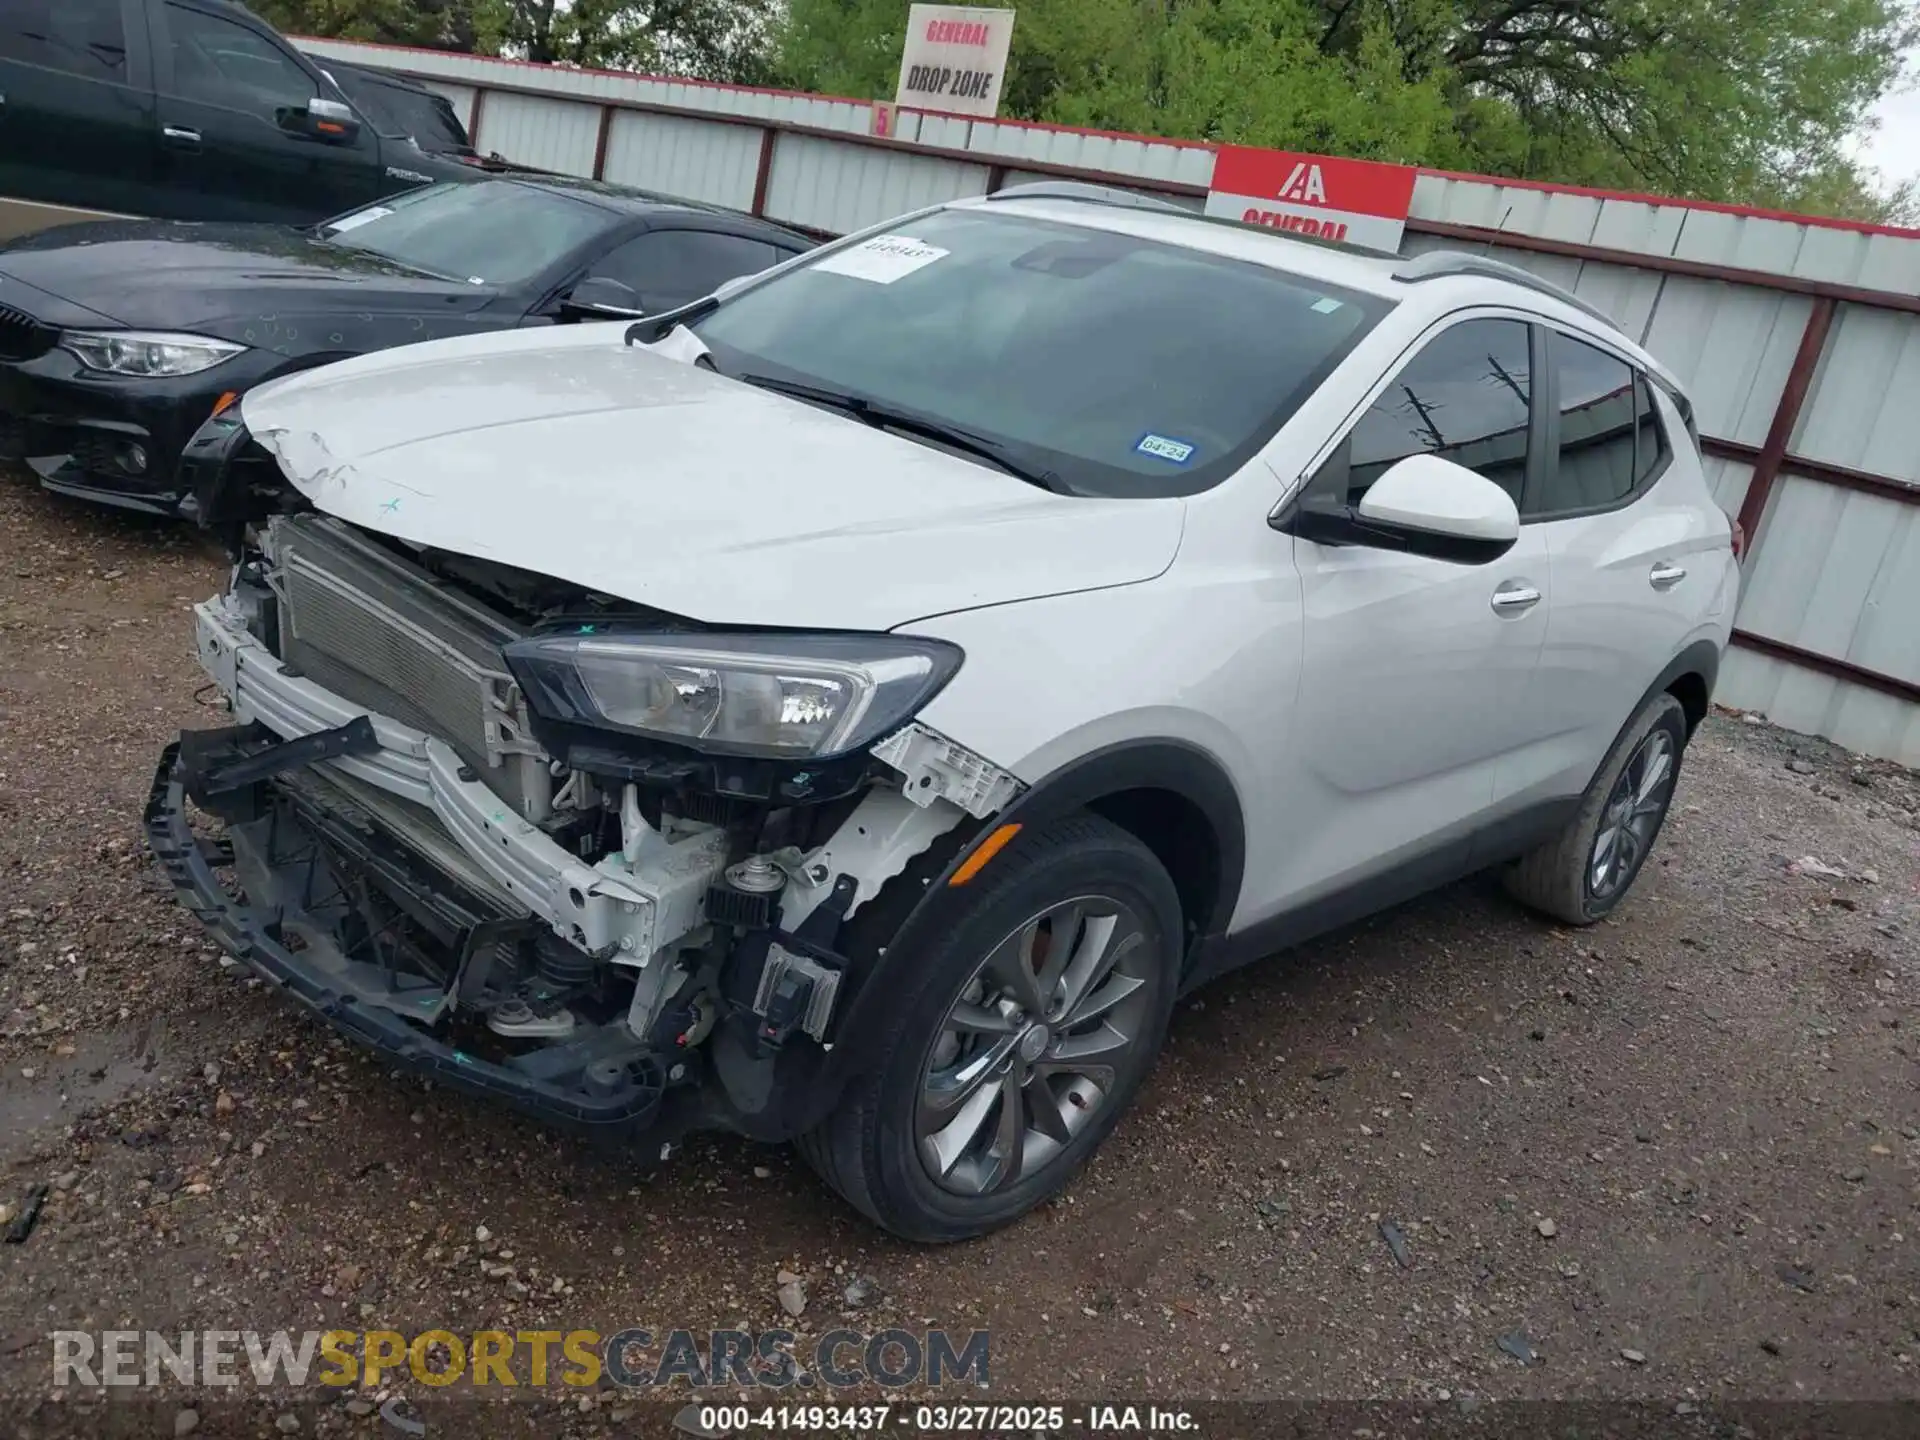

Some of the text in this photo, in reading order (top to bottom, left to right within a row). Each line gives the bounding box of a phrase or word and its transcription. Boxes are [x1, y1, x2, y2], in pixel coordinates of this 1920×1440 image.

[926, 20, 989, 47] GENERAL
[906, 65, 994, 99] DROP ZONE
[876, 106, 889, 136] 5
